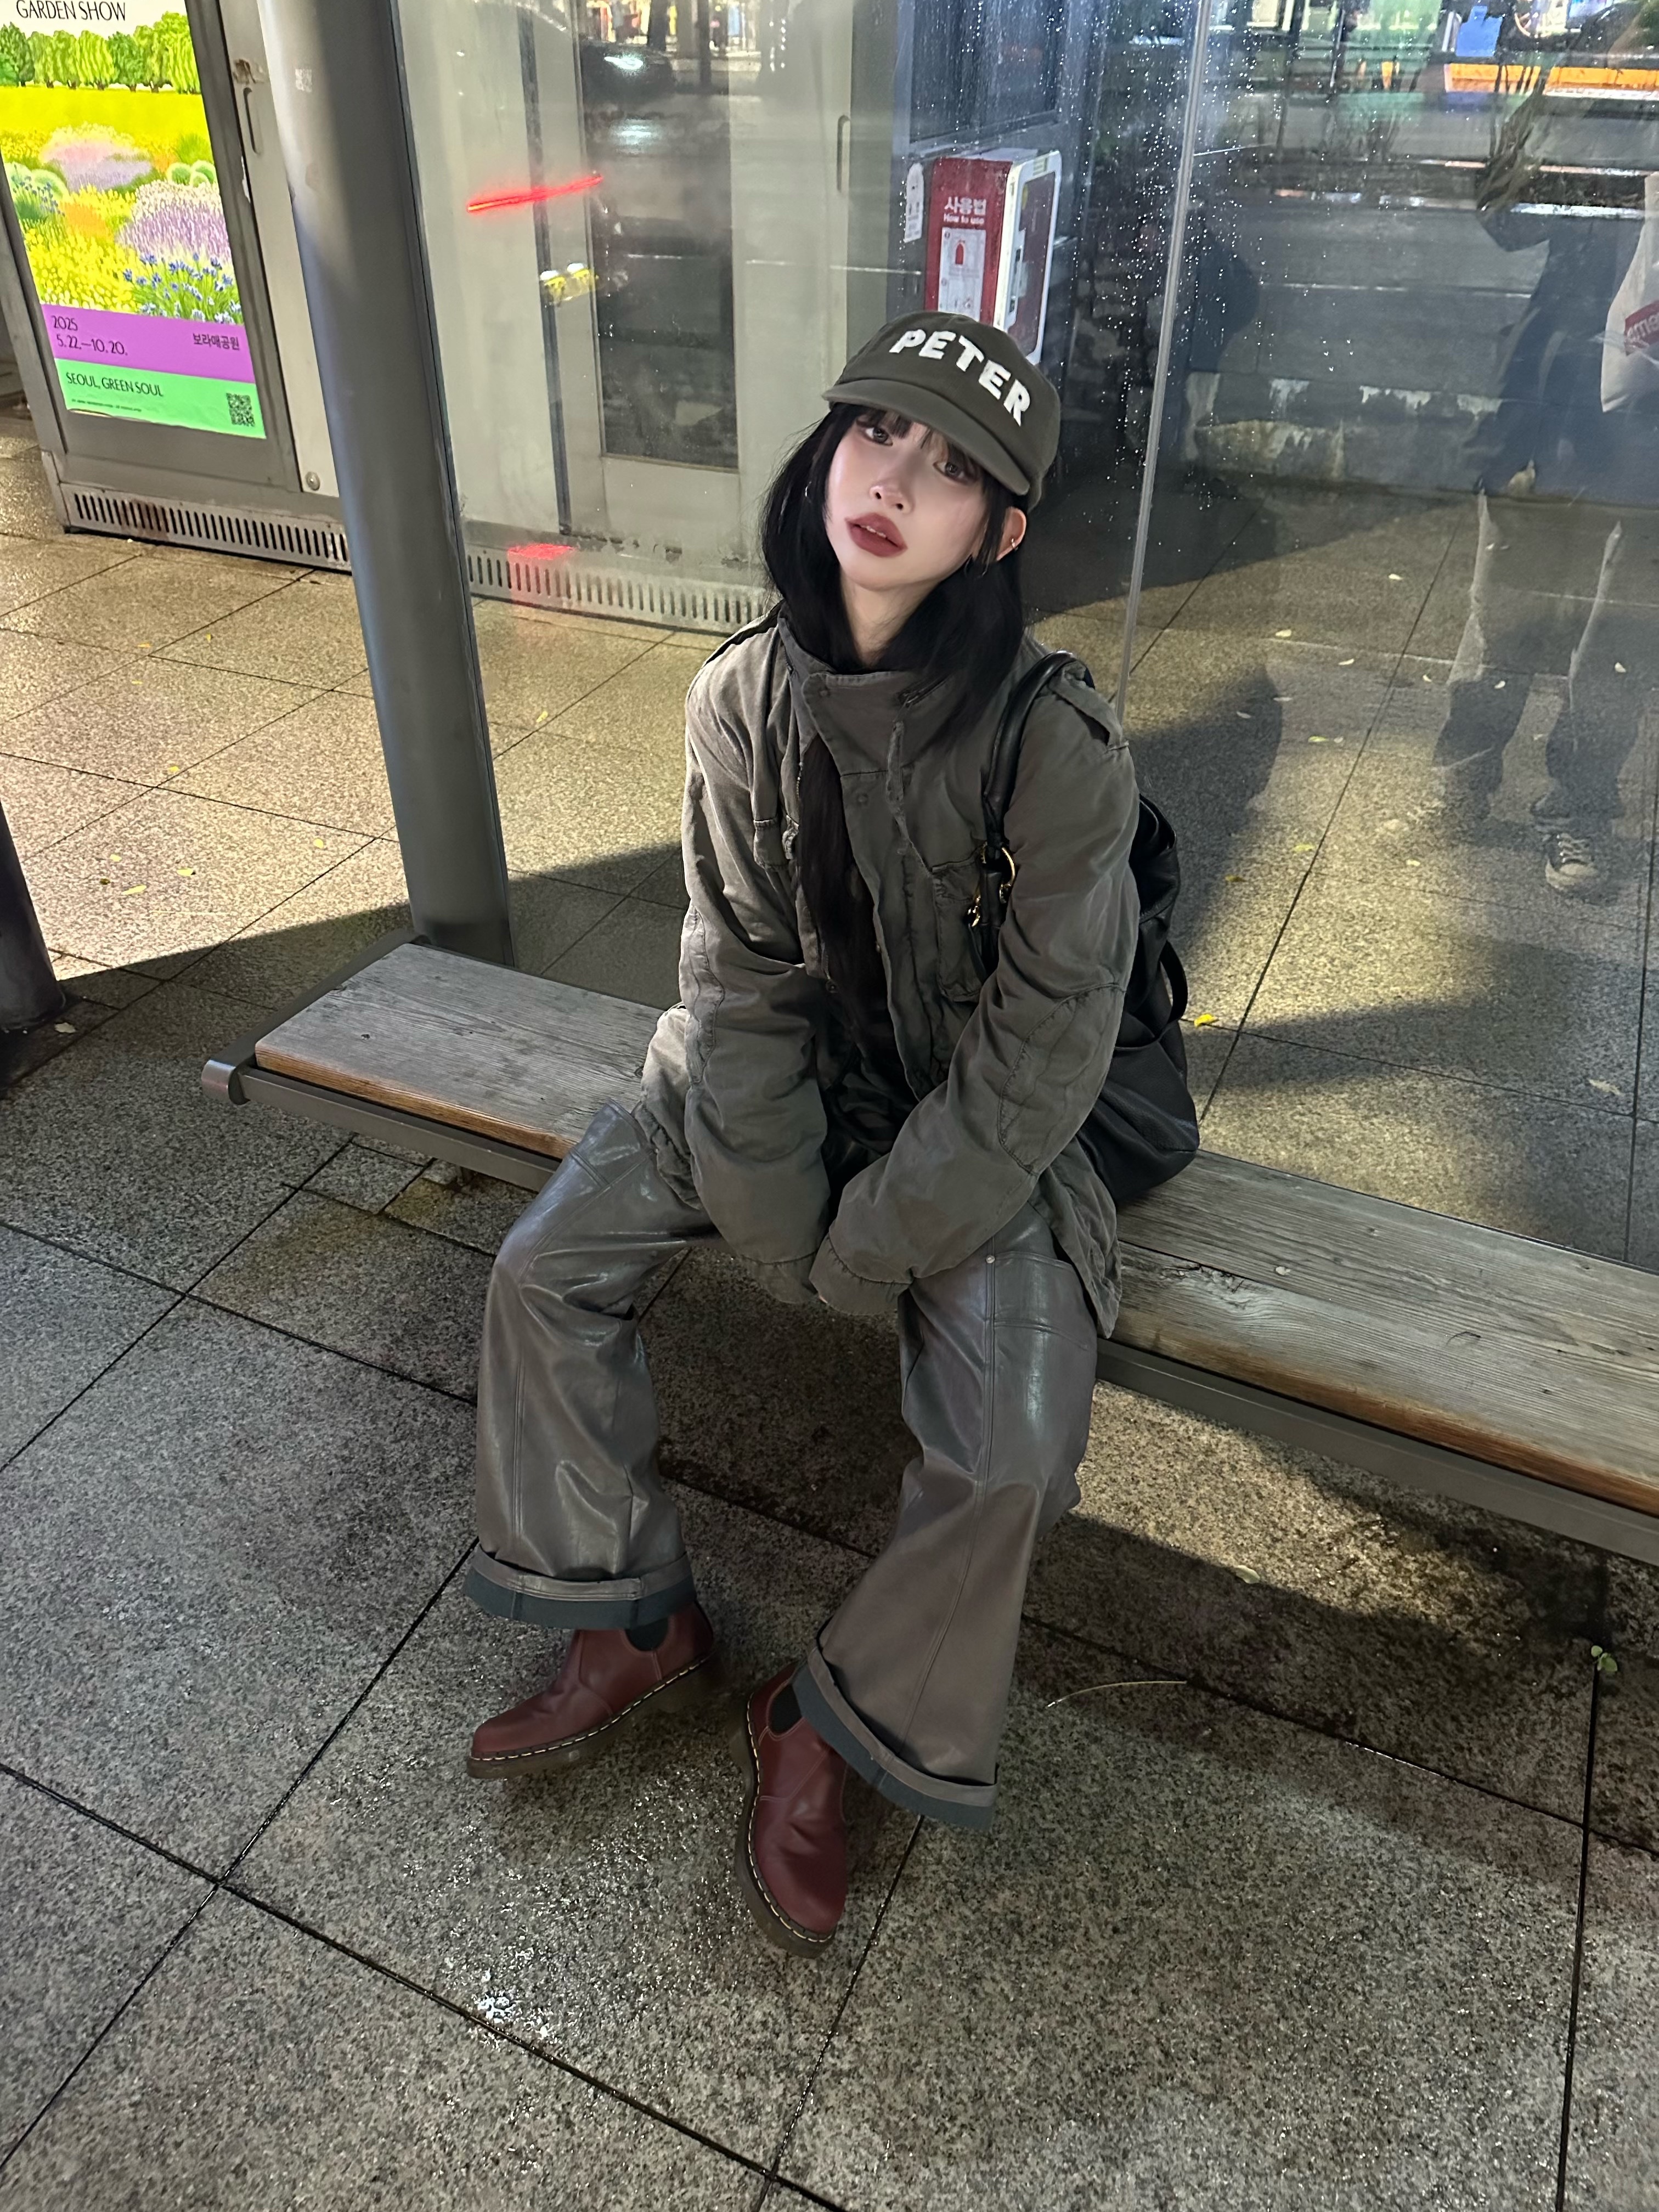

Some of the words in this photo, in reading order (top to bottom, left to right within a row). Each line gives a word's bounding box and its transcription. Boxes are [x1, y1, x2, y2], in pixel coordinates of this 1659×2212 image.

[16, 0, 77, 20] GARDEN
[78, 1, 126, 21] SHOW
[944, 196, 986, 216] 사용법
[52, 315, 78, 331] 2025
[193, 332, 240, 351] 보라매공원
[66, 372, 100, 389] SEOUL,
[101, 377, 134, 393] GREEN
[135, 381, 163, 397] SOUL
[889, 329, 1031, 427] PETER
